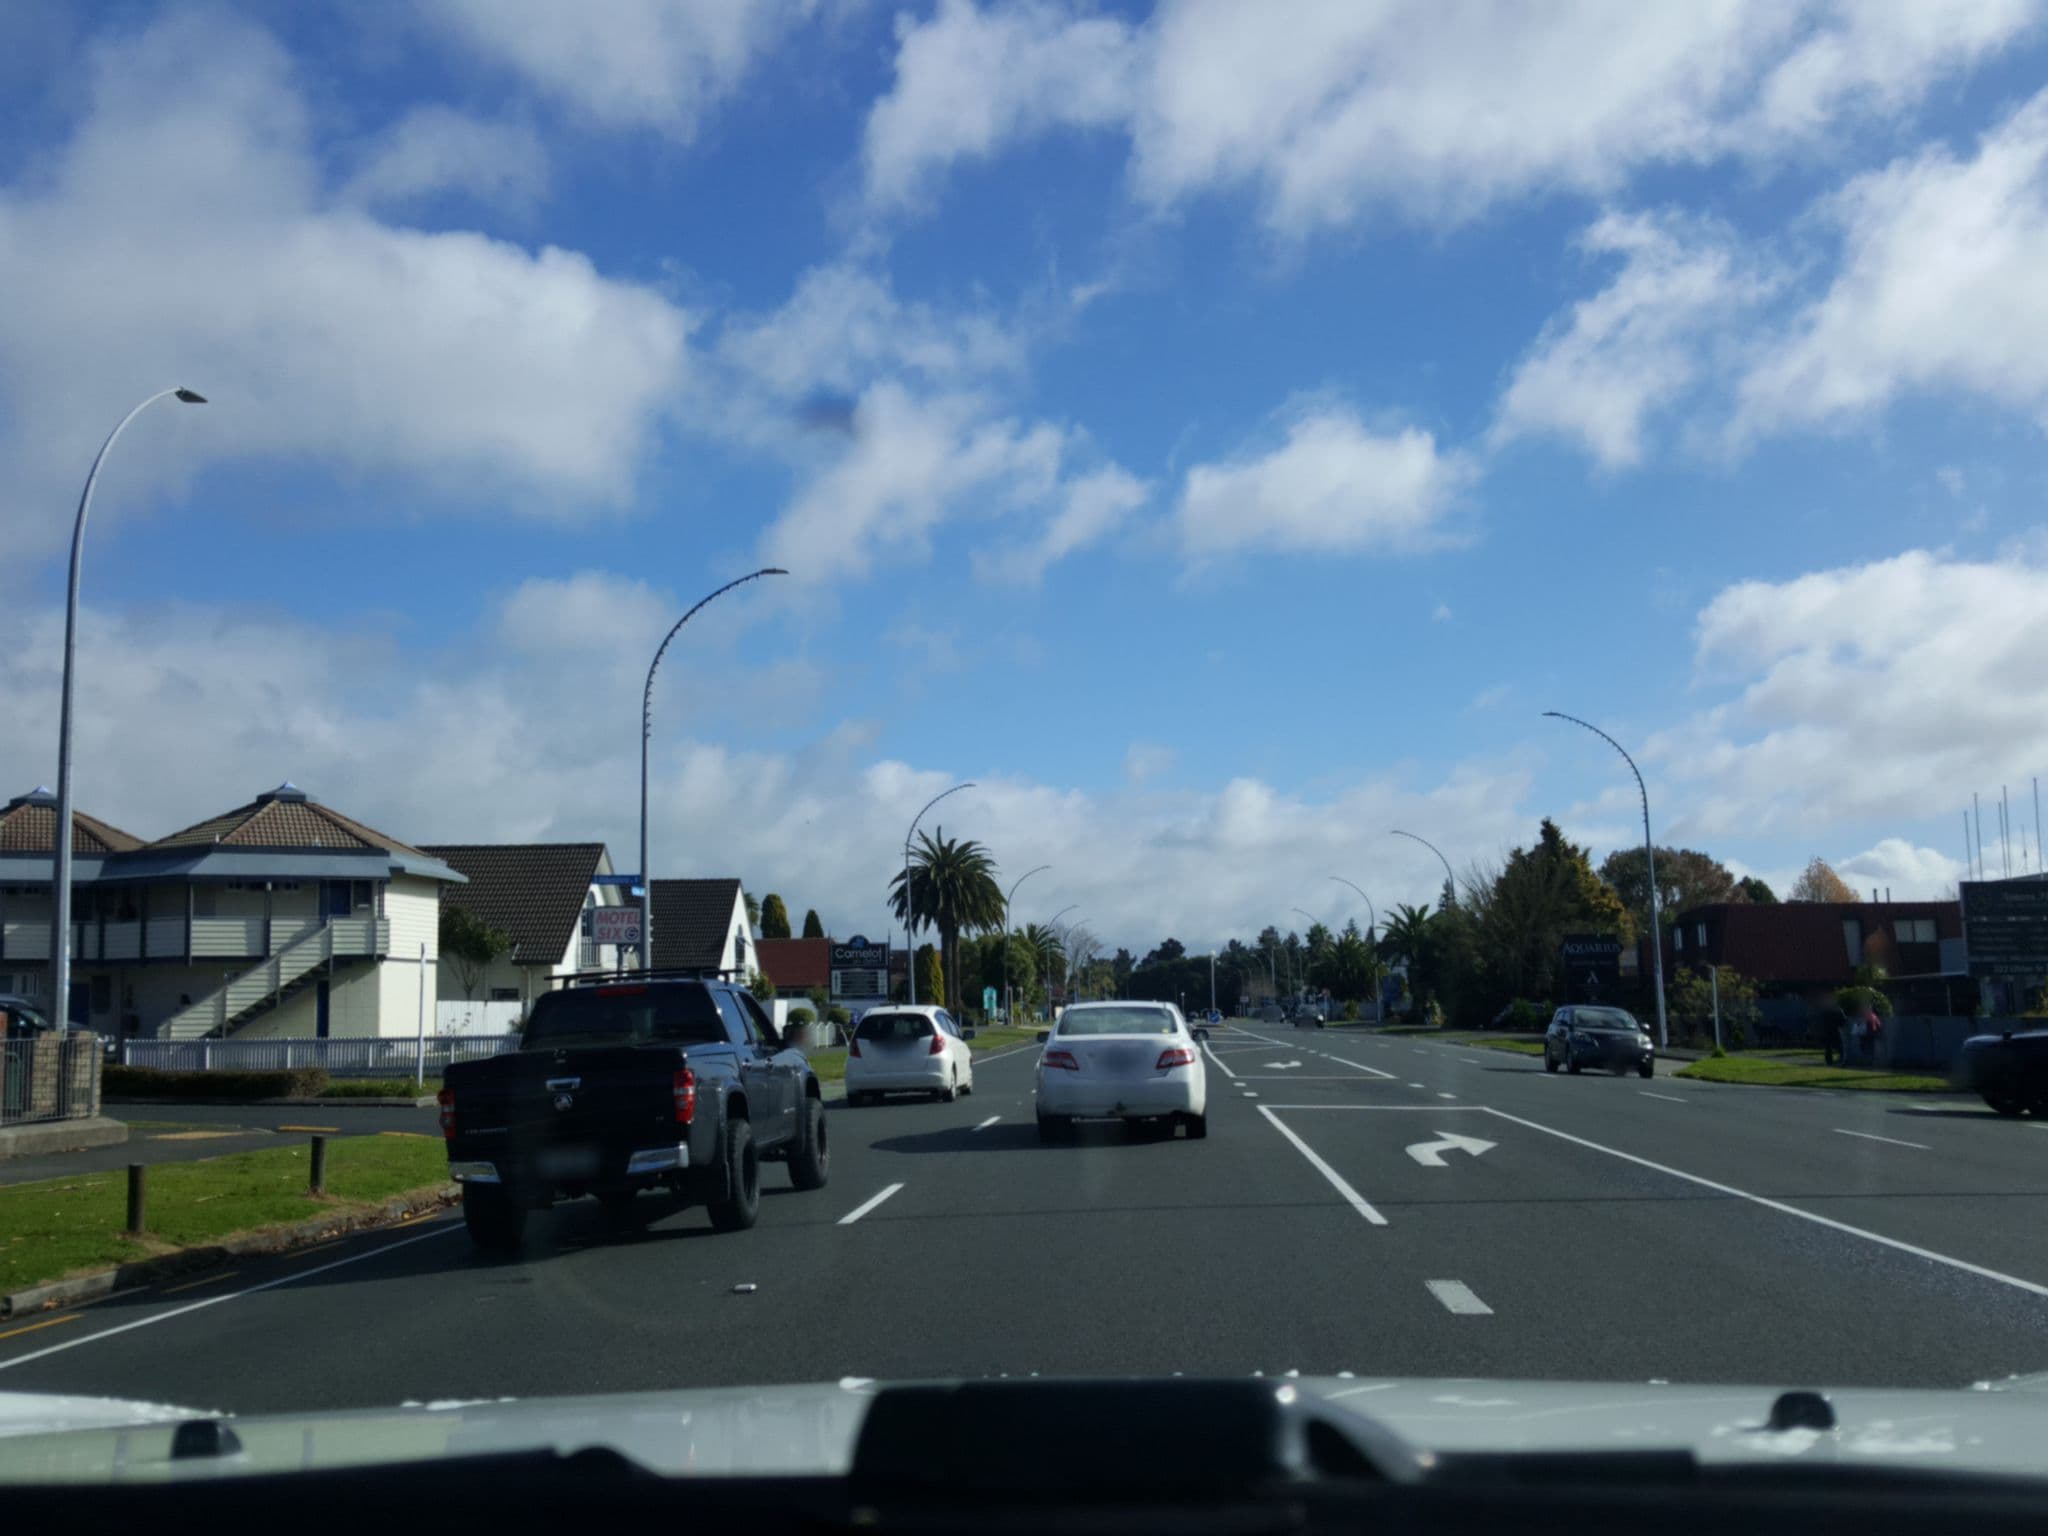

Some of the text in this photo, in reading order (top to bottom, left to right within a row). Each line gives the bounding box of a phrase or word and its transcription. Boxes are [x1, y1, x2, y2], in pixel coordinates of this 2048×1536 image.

[597, 911, 640, 924] MOTEL
[597, 927, 622, 940] SIX
[835, 947, 882, 960] Camelot
